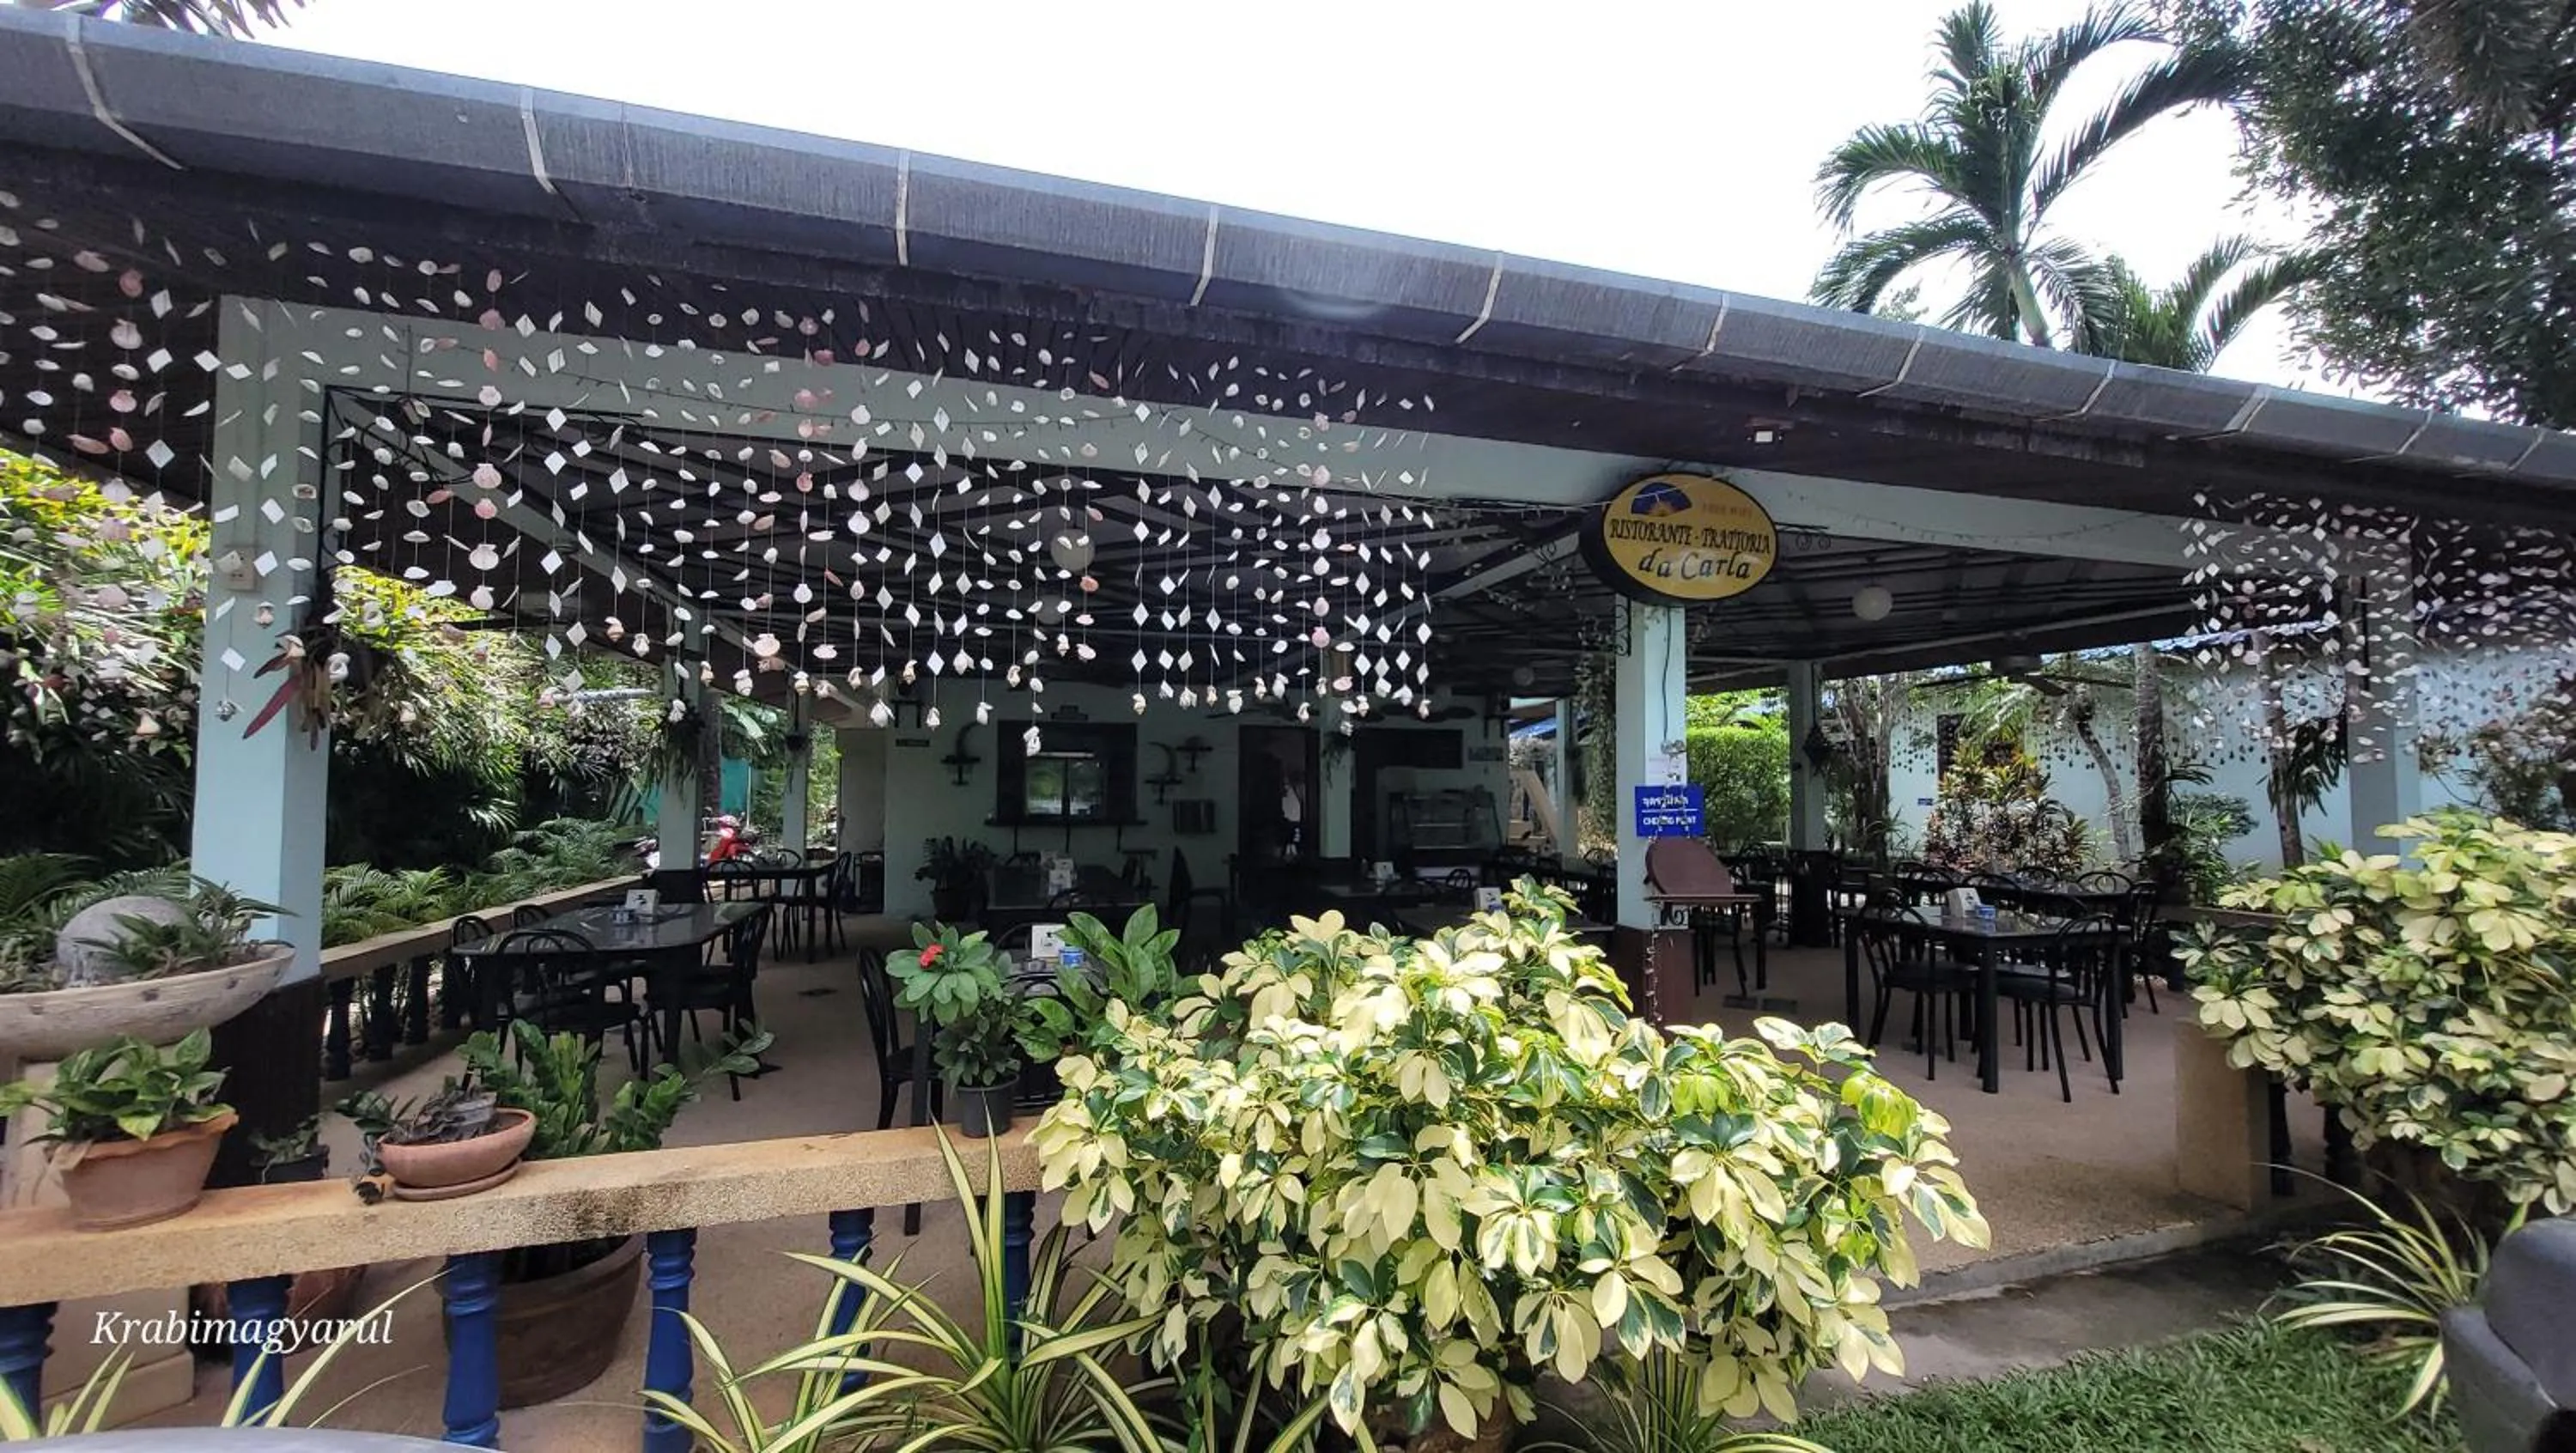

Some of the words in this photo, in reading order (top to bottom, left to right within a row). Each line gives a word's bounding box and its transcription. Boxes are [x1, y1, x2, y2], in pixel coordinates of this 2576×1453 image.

[1609, 518, 1693, 546] RISTORANTE
[1701, 526, 1771, 555] TRATTORIA
[1638, 547, 1673, 578] da
[1680, 550, 1752, 581] Carla
